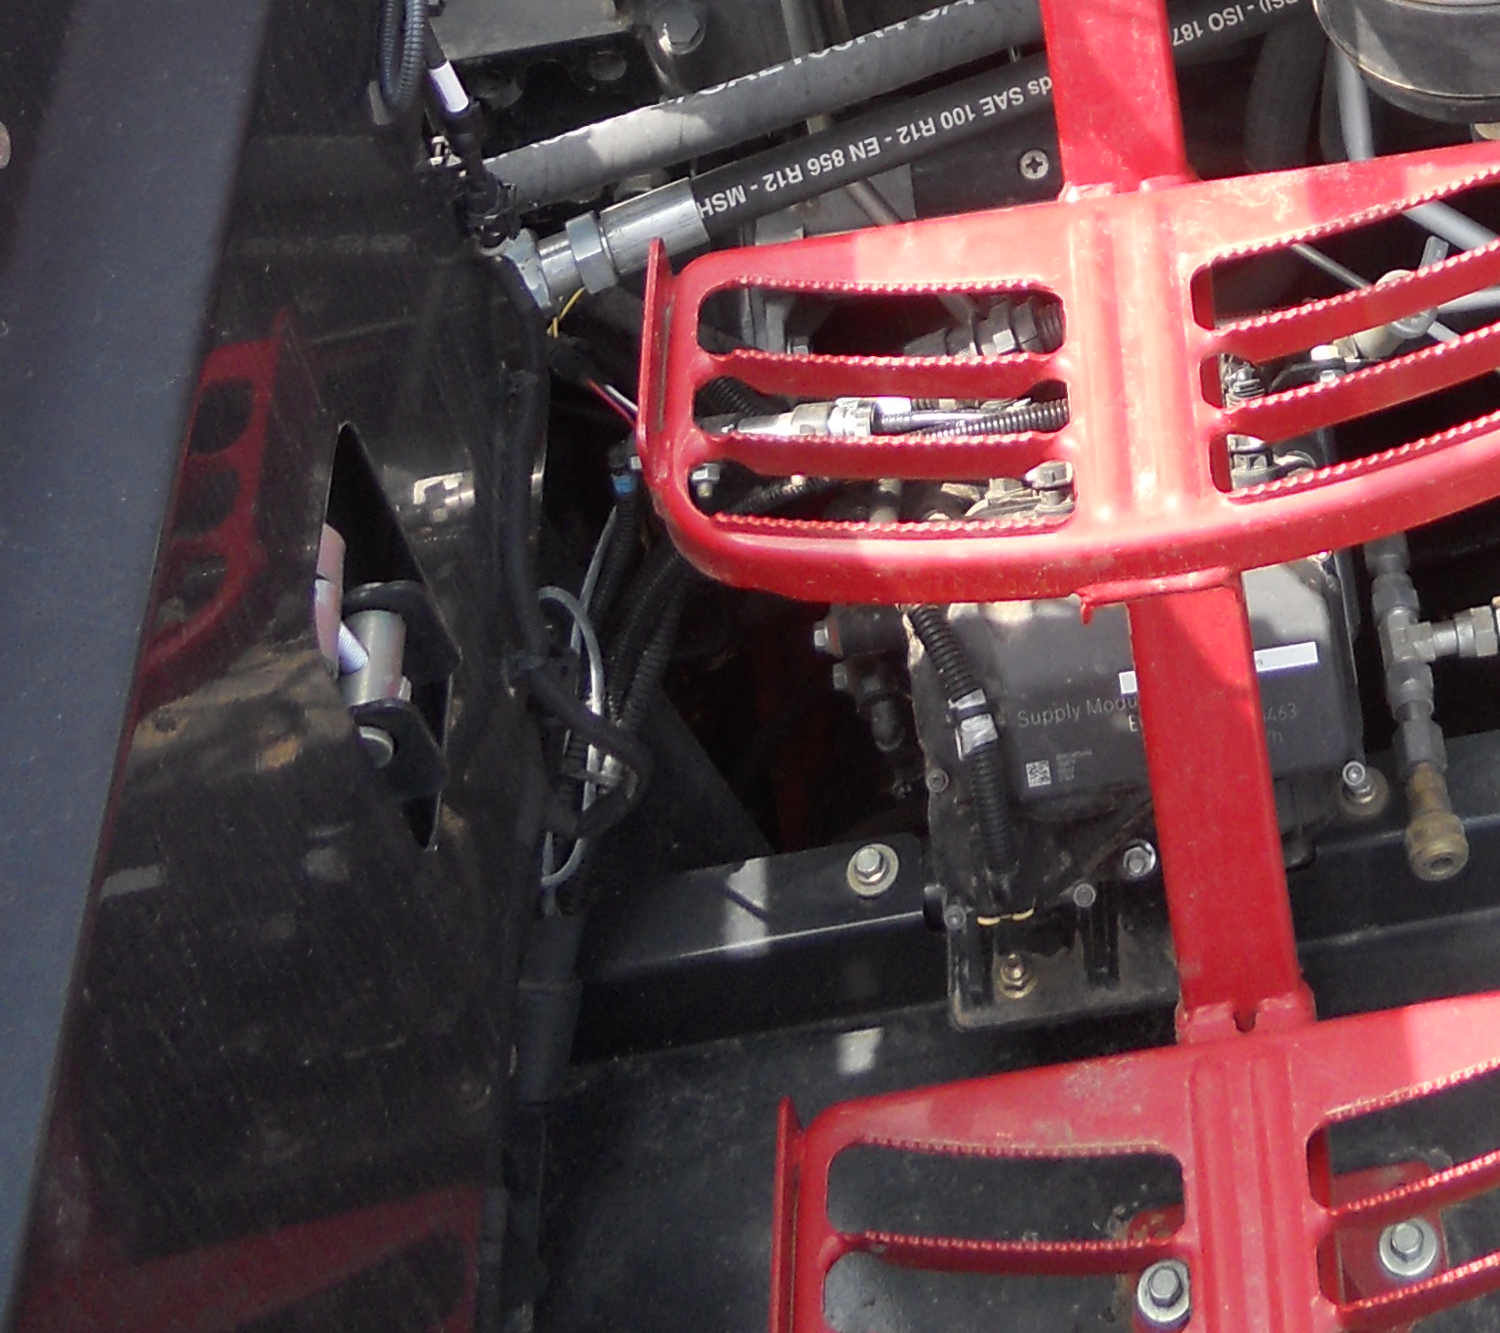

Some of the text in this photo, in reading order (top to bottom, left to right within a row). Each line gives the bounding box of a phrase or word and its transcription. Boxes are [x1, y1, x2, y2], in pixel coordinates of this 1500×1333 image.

[1209, 5, 1243, 30] ISO
[979, 87, 1024, 116] SAE
[940, 105, 975, 129] 100
[896, 117, 936, 144] R12
[807, 149, 845, 175] 856
[849, 137, 880, 162] EN
[762, 164, 803, 192] R12
[1017, 702, 1080, 729] Supply
